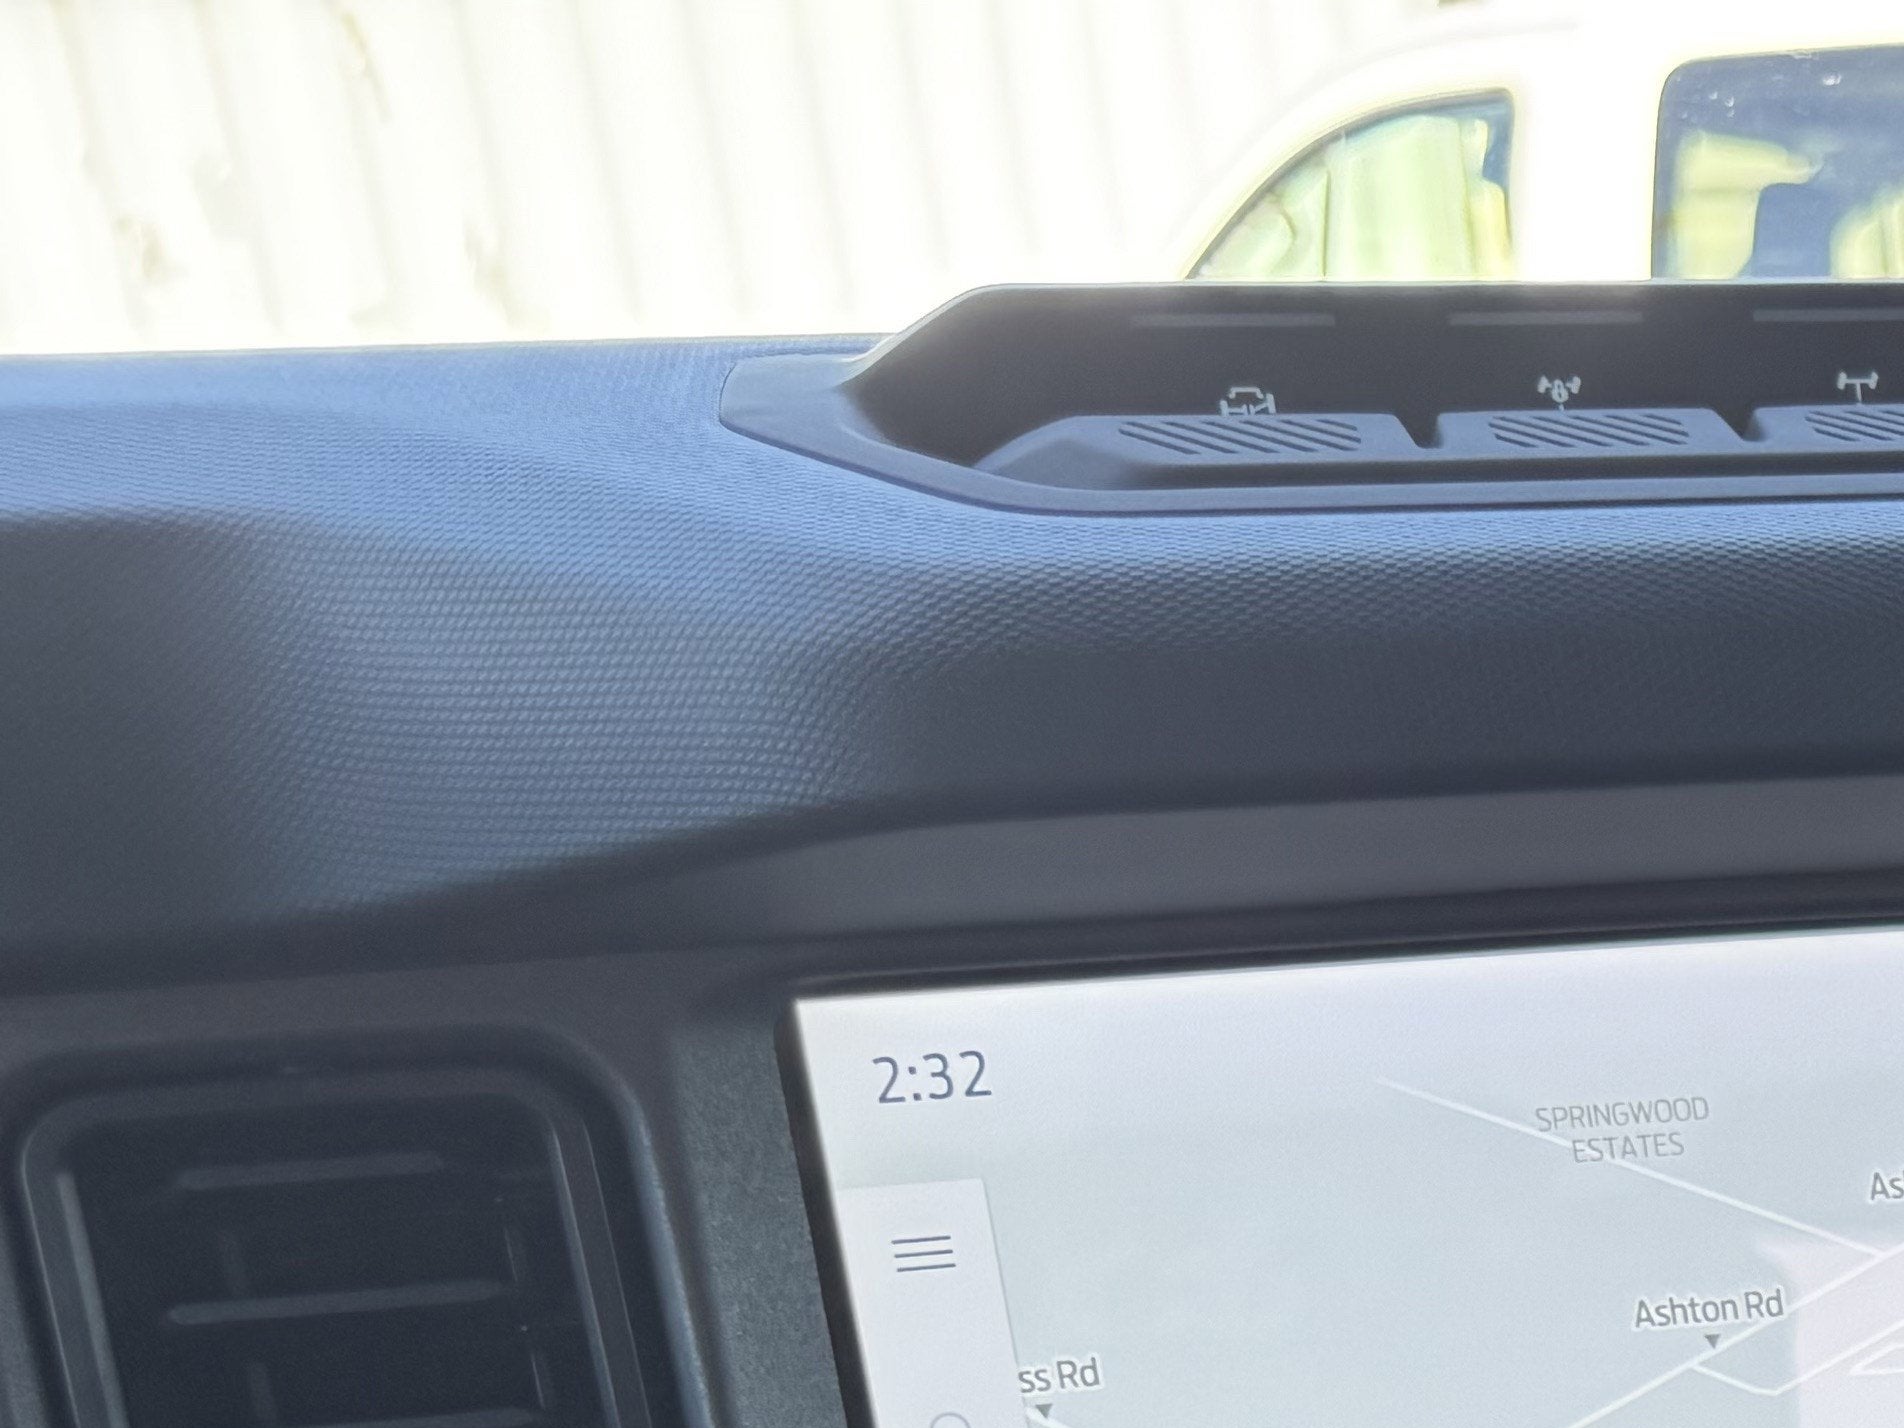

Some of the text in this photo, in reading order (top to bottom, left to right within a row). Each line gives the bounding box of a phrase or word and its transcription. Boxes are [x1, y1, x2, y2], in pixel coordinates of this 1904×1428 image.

[873, 1051, 991, 1103] 2:32
[1534, 1097, 1709, 1132] SPRINGWOOD
[1572, 1132, 1684, 1163] ESTATES
[1636, 1289, 1783, 1327] Ashton Rd
[1057, 1357, 1099, 1388] Rd
